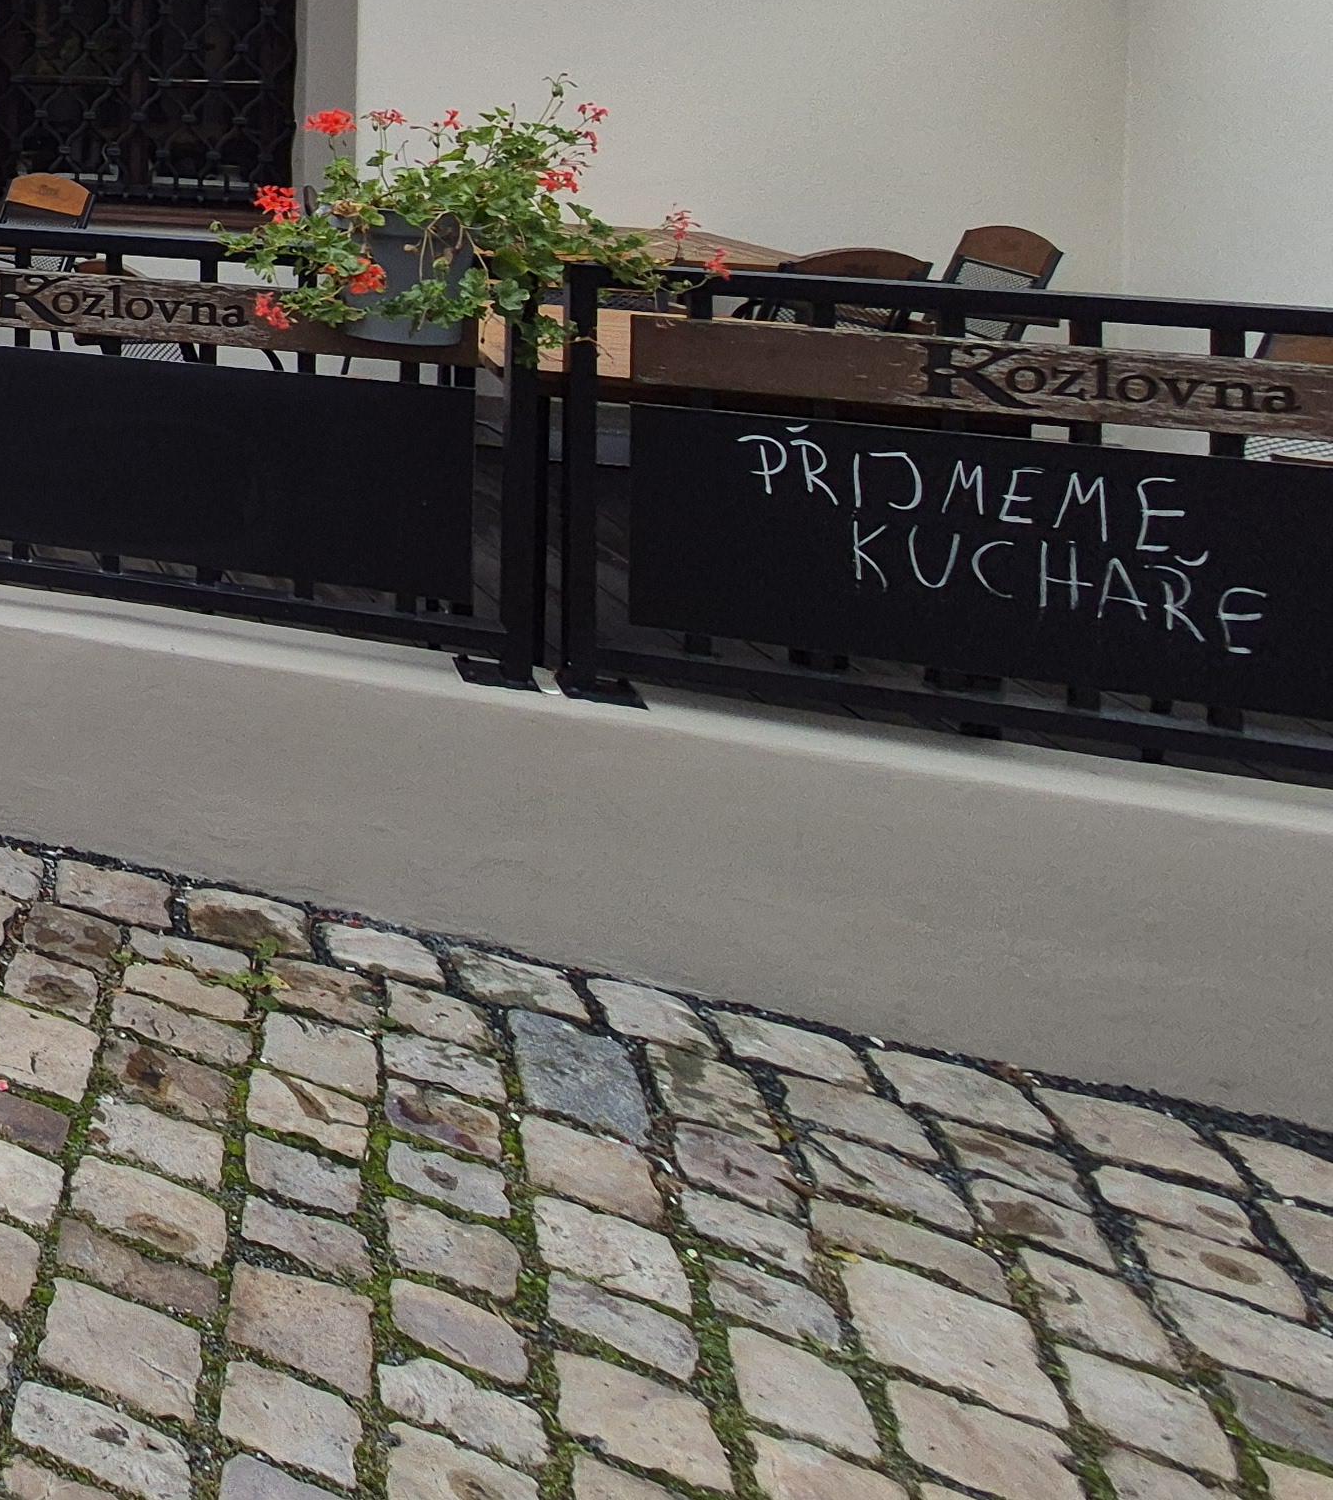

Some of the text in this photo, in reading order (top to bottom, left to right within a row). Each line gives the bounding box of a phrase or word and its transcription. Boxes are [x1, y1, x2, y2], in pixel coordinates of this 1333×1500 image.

[919, 343, 1303, 414] Kozlovna
[736, 424, 1186, 552] PŘIJMEME
[851, 520, 1268, 655] KUCHAŘE
